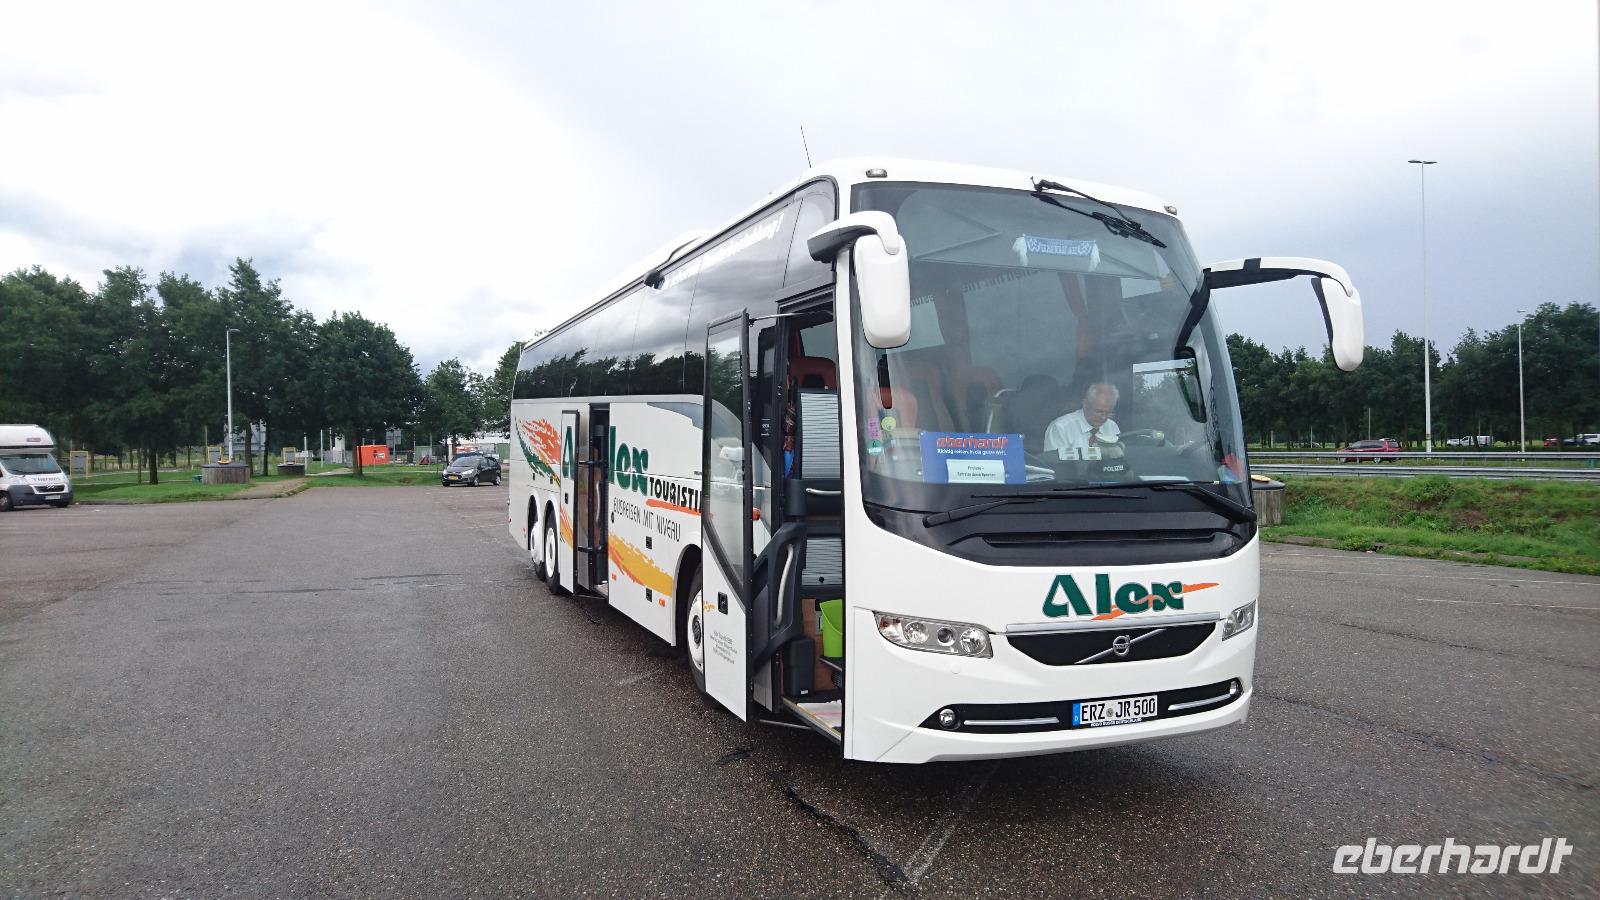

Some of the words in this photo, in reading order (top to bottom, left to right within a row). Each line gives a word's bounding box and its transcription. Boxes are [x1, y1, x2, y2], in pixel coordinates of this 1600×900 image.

[936, 436, 1008, 449] eberhardt
[649, 477, 702, 513] TOURISTI
[643, 509, 654, 530] MIT
[656, 514, 681, 542] NIVEAU
[1042, 573, 1185, 618] Alex
[1081, 703, 1106, 722] ERZ
[1115, 700, 1131, 718] JR
[1134, 697, 1156, 716] 500
